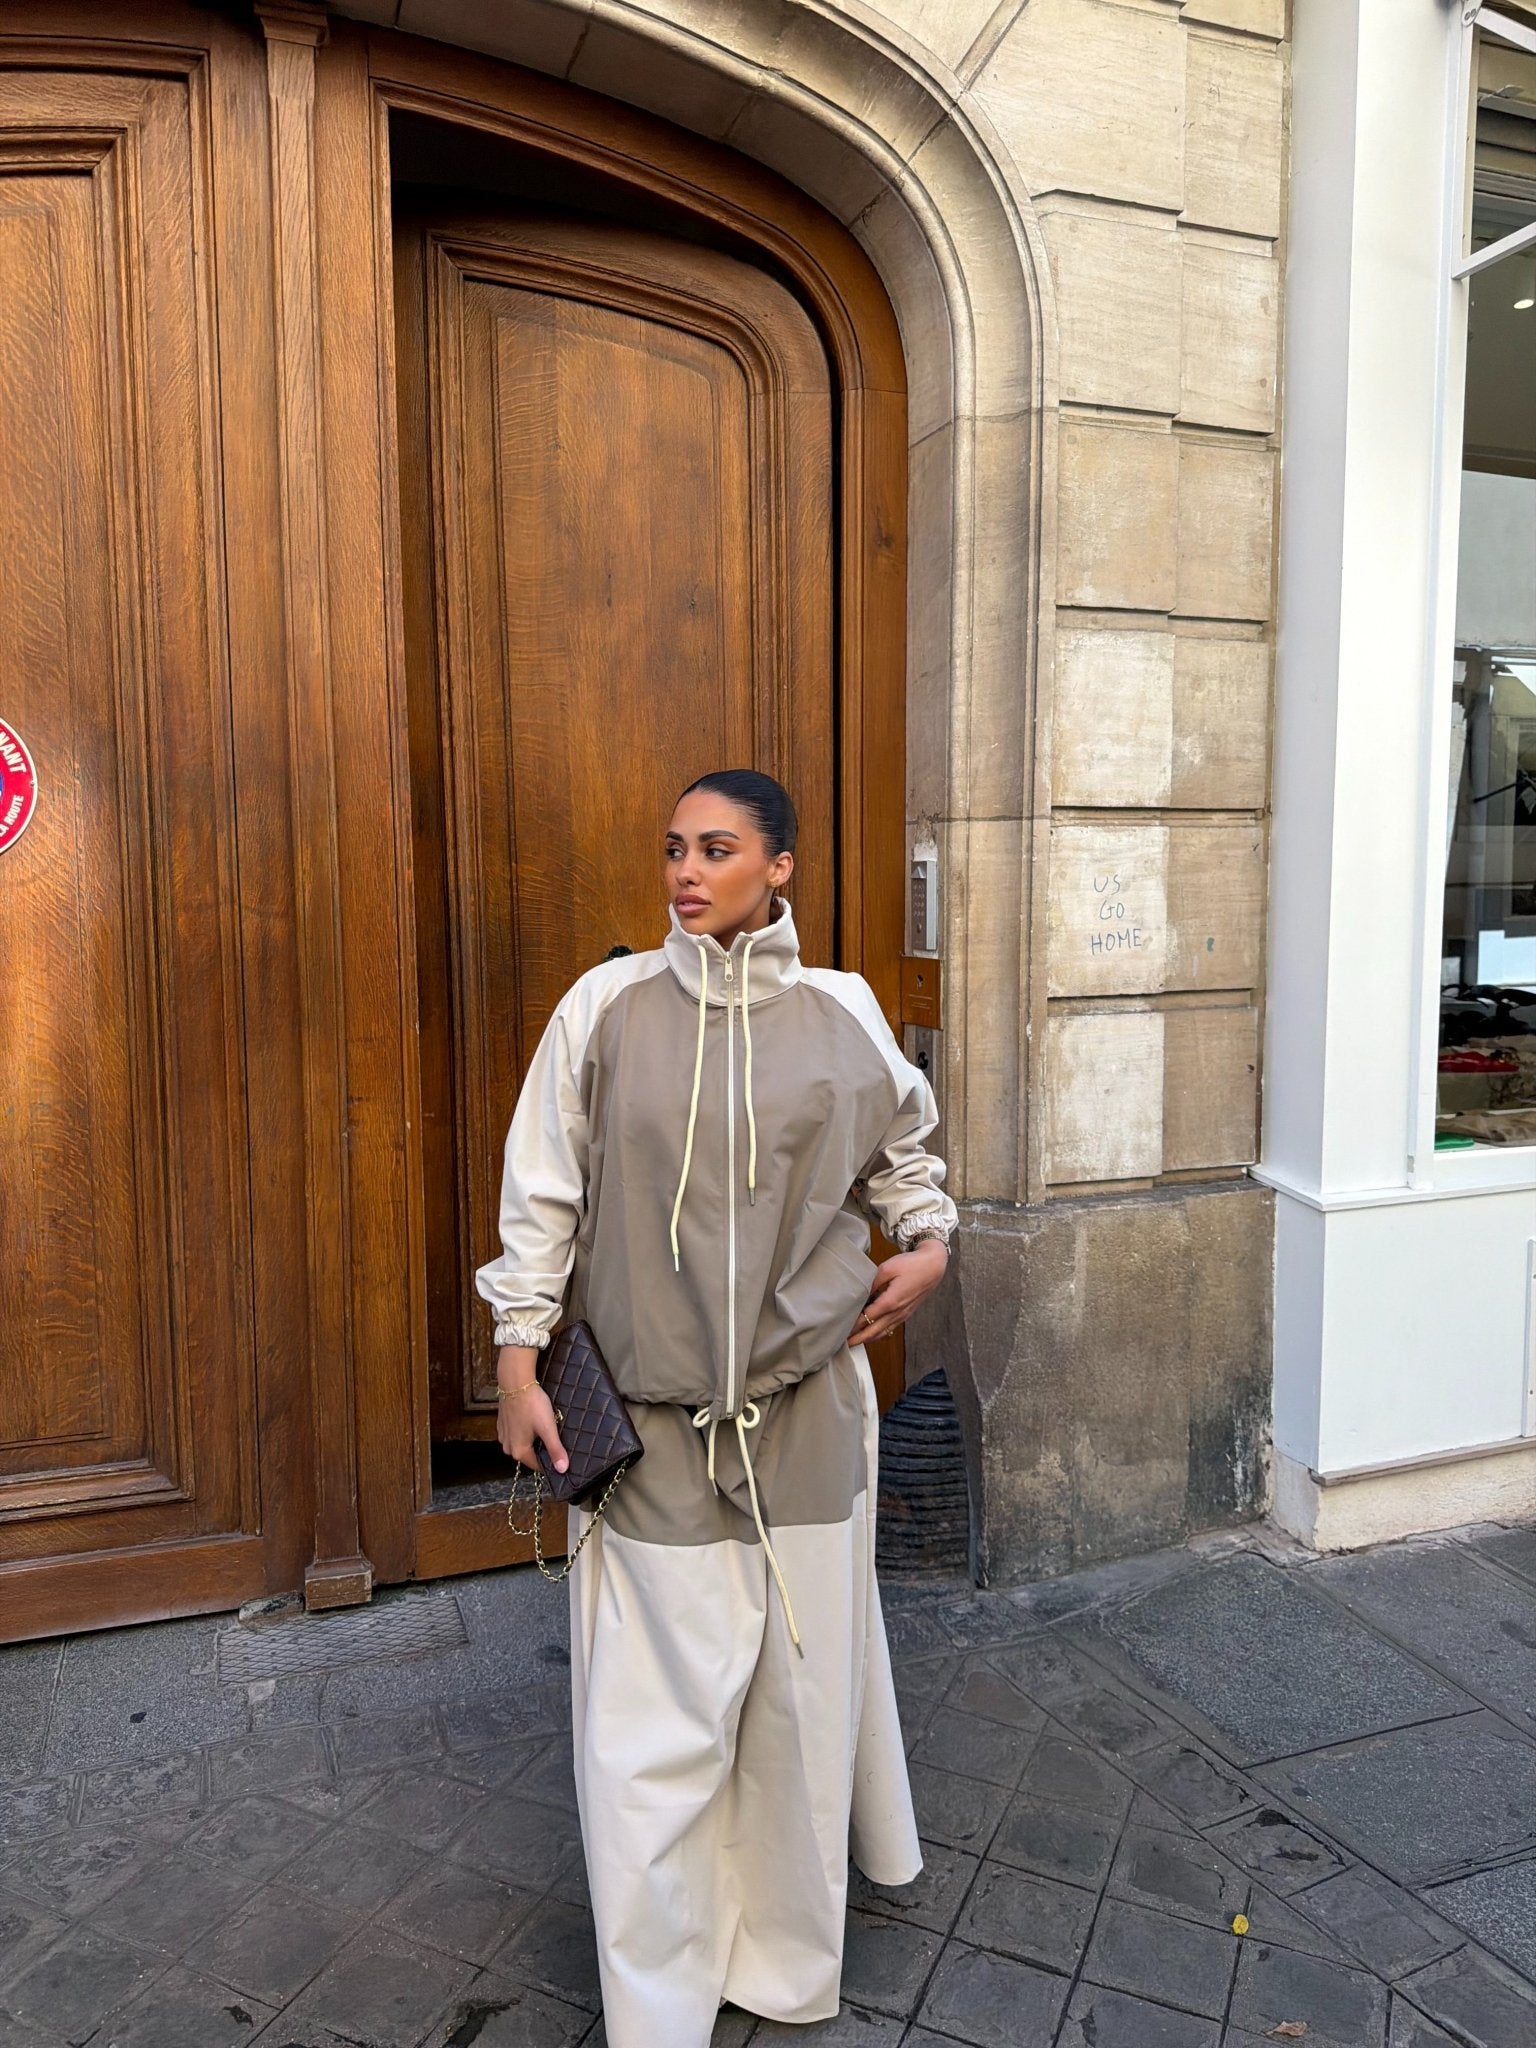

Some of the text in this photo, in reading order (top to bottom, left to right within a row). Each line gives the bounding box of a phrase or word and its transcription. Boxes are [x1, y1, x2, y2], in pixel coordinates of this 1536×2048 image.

[3, 794, 24, 826] ROUTE
[1093, 874, 1121, 895] US
[1099, 899, 1125, 920] GO
[1091, 928, 1142, 956] HOME
